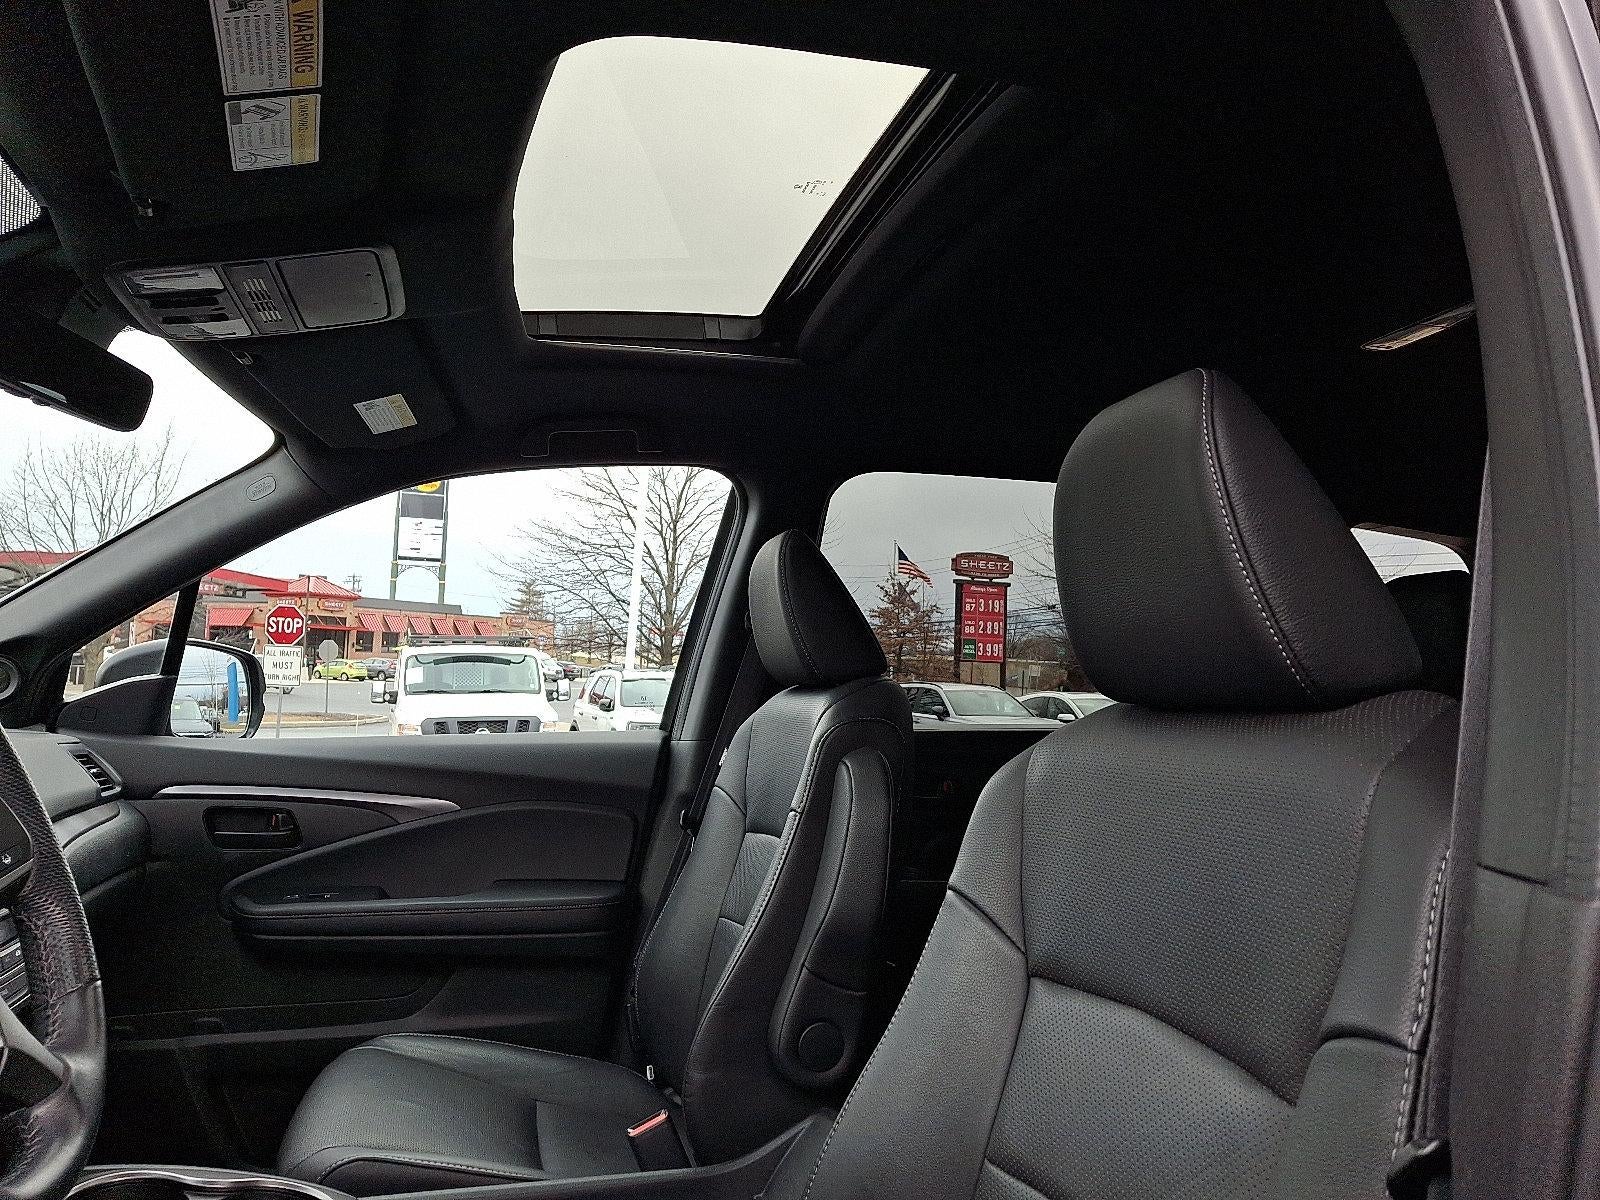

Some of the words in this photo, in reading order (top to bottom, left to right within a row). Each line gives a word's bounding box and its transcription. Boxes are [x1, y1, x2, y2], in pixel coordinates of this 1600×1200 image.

[292, 10, 314, 74] WARNING
[961, 560, 1010, 571] SHEETZ
[965, 603, 976, 612] 87
[979, 598, 1000, 613] 3.19
[268, 616, 303, 634] STOP
[964, 626, 976, 634] 88
[978, 620, 999, 635] 2.89
[266, 649, 277, 657] ALL
[279, 649, 301, 658] TRAFFIC
[977, 642, 999, 657] 3.99
[272, 661, 294, 670] MUST
